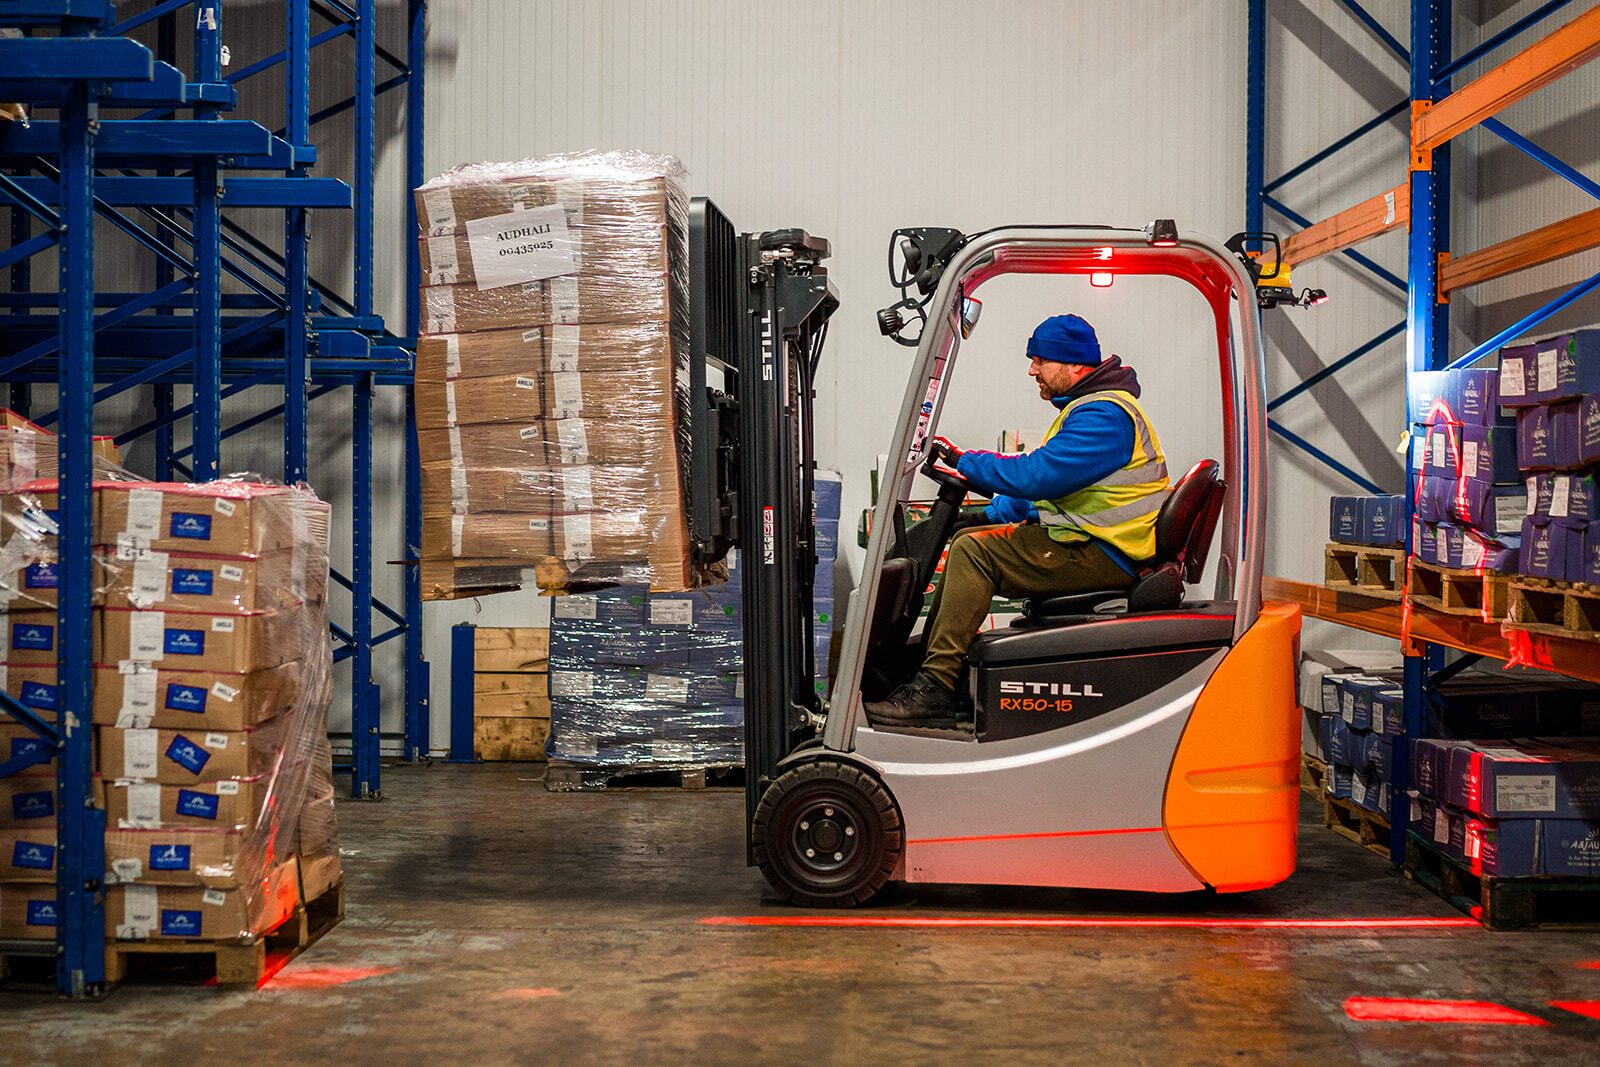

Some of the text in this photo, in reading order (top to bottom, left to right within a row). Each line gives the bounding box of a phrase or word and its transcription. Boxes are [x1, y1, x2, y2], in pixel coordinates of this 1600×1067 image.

[496, 223, 552, 242] AUDHALI
[761, 309, 773, 381] STILL
[517, 379, 534, 387] ANGLIA
[521, 428, 538, 438] ANGLIA
[1000, 681, 1104, 697] STILL
[1000, 697, 1073, 712] RX50-15
